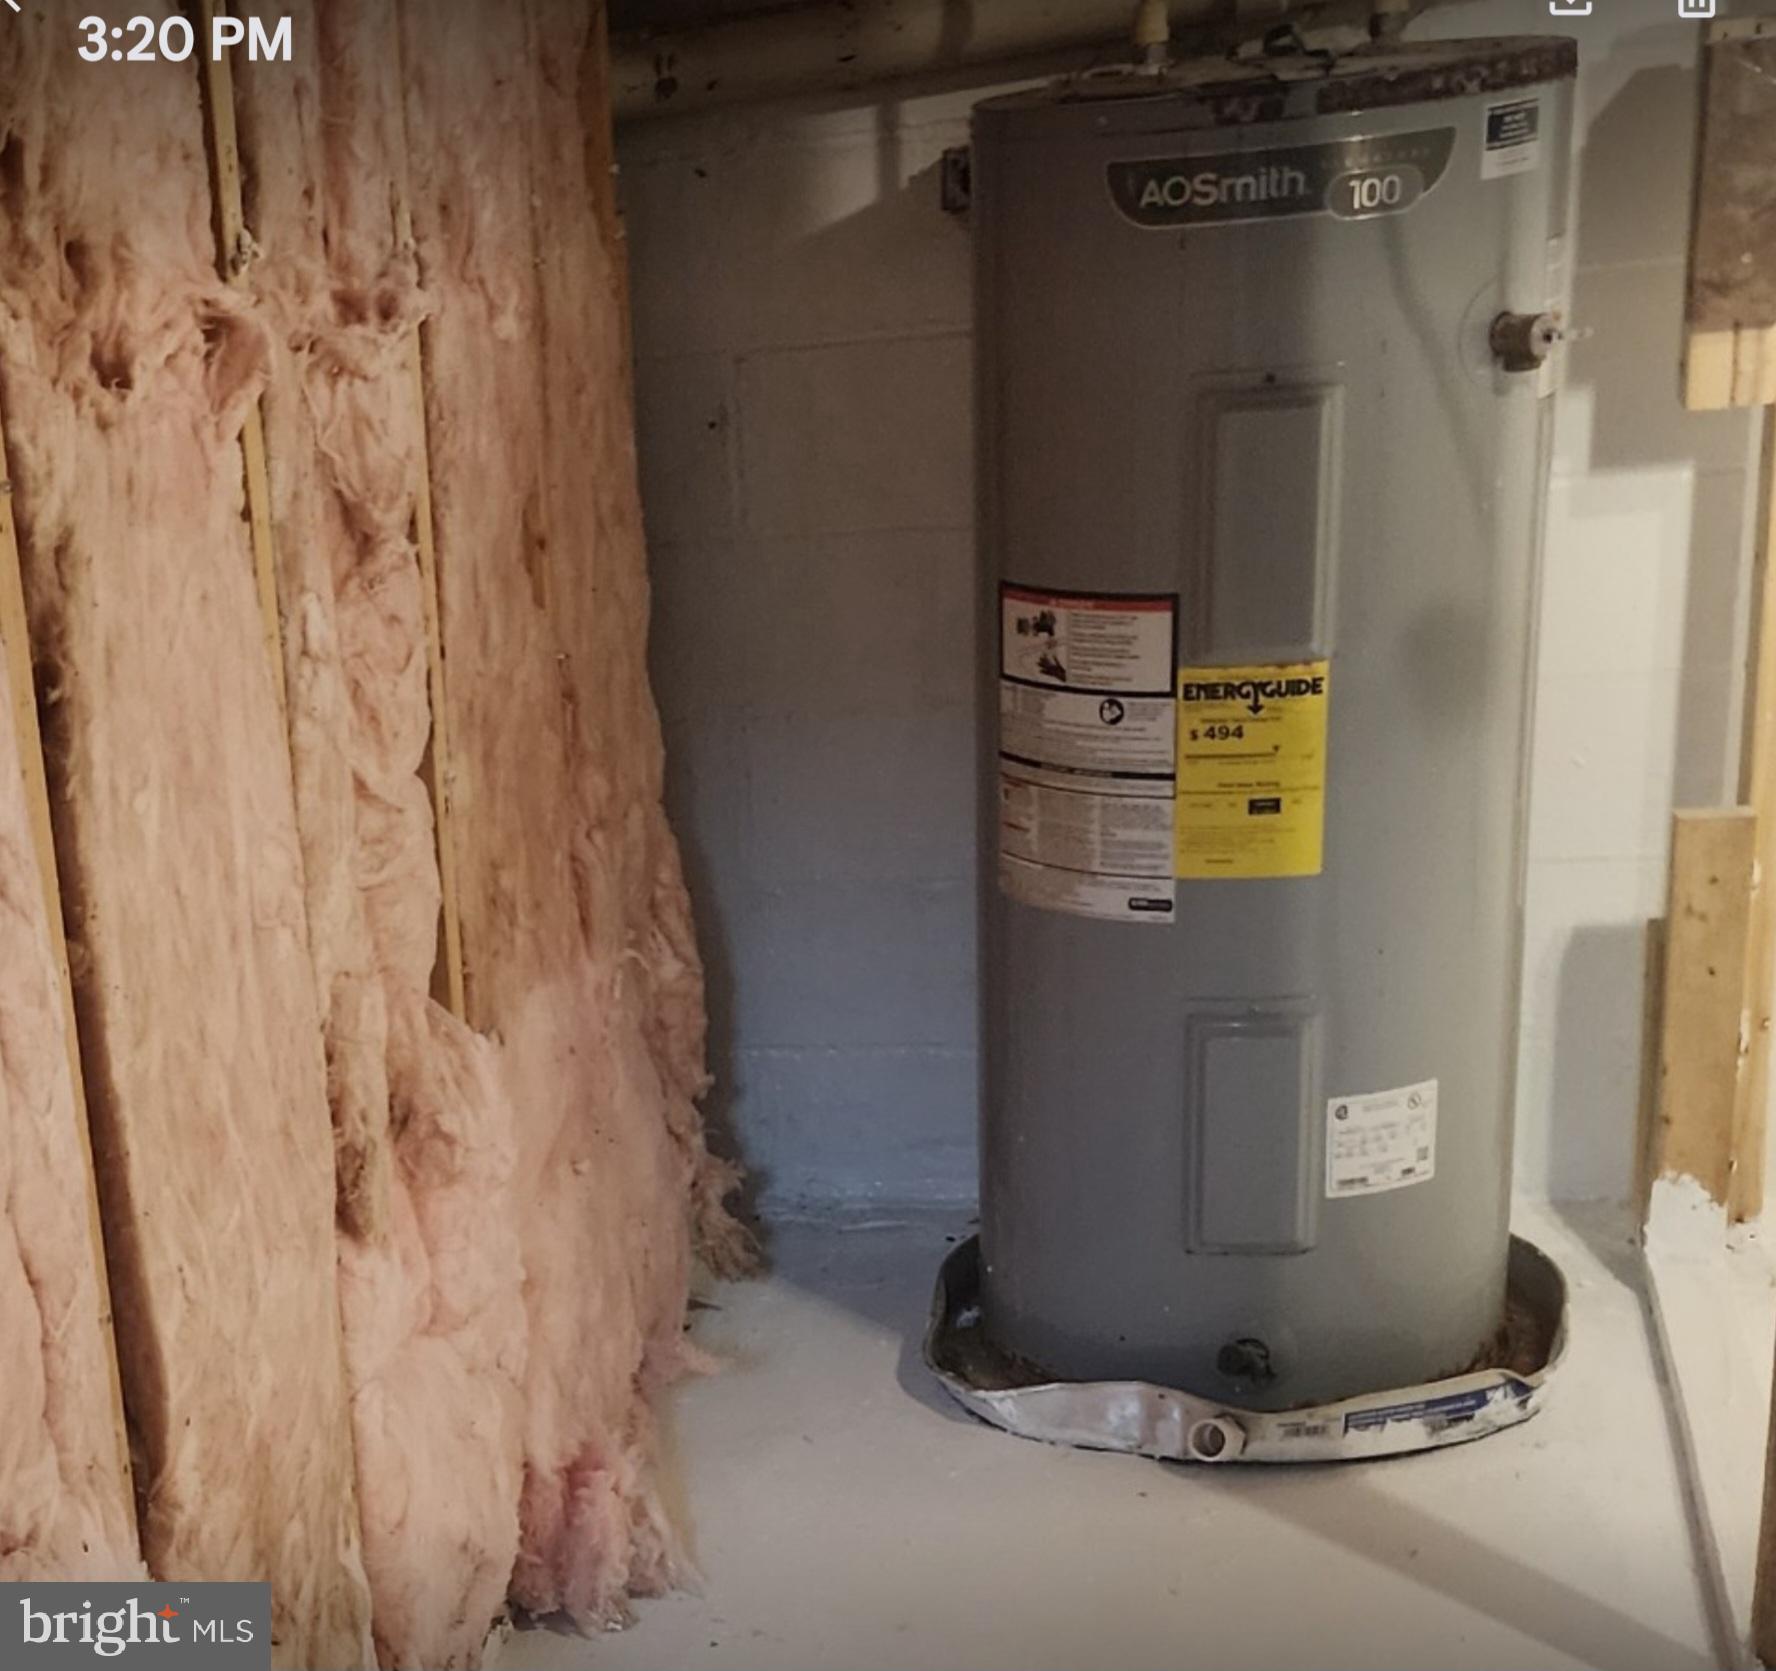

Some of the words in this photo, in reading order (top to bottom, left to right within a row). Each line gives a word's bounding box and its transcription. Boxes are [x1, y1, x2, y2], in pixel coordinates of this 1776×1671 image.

[1138, 164, 1307, 210] AOSmith
[1348, 174, 1402, 210] 100
[1183, 677, 1324, 707] ENERGYGUIDE
[1203, 725, 1244, 741] 494
